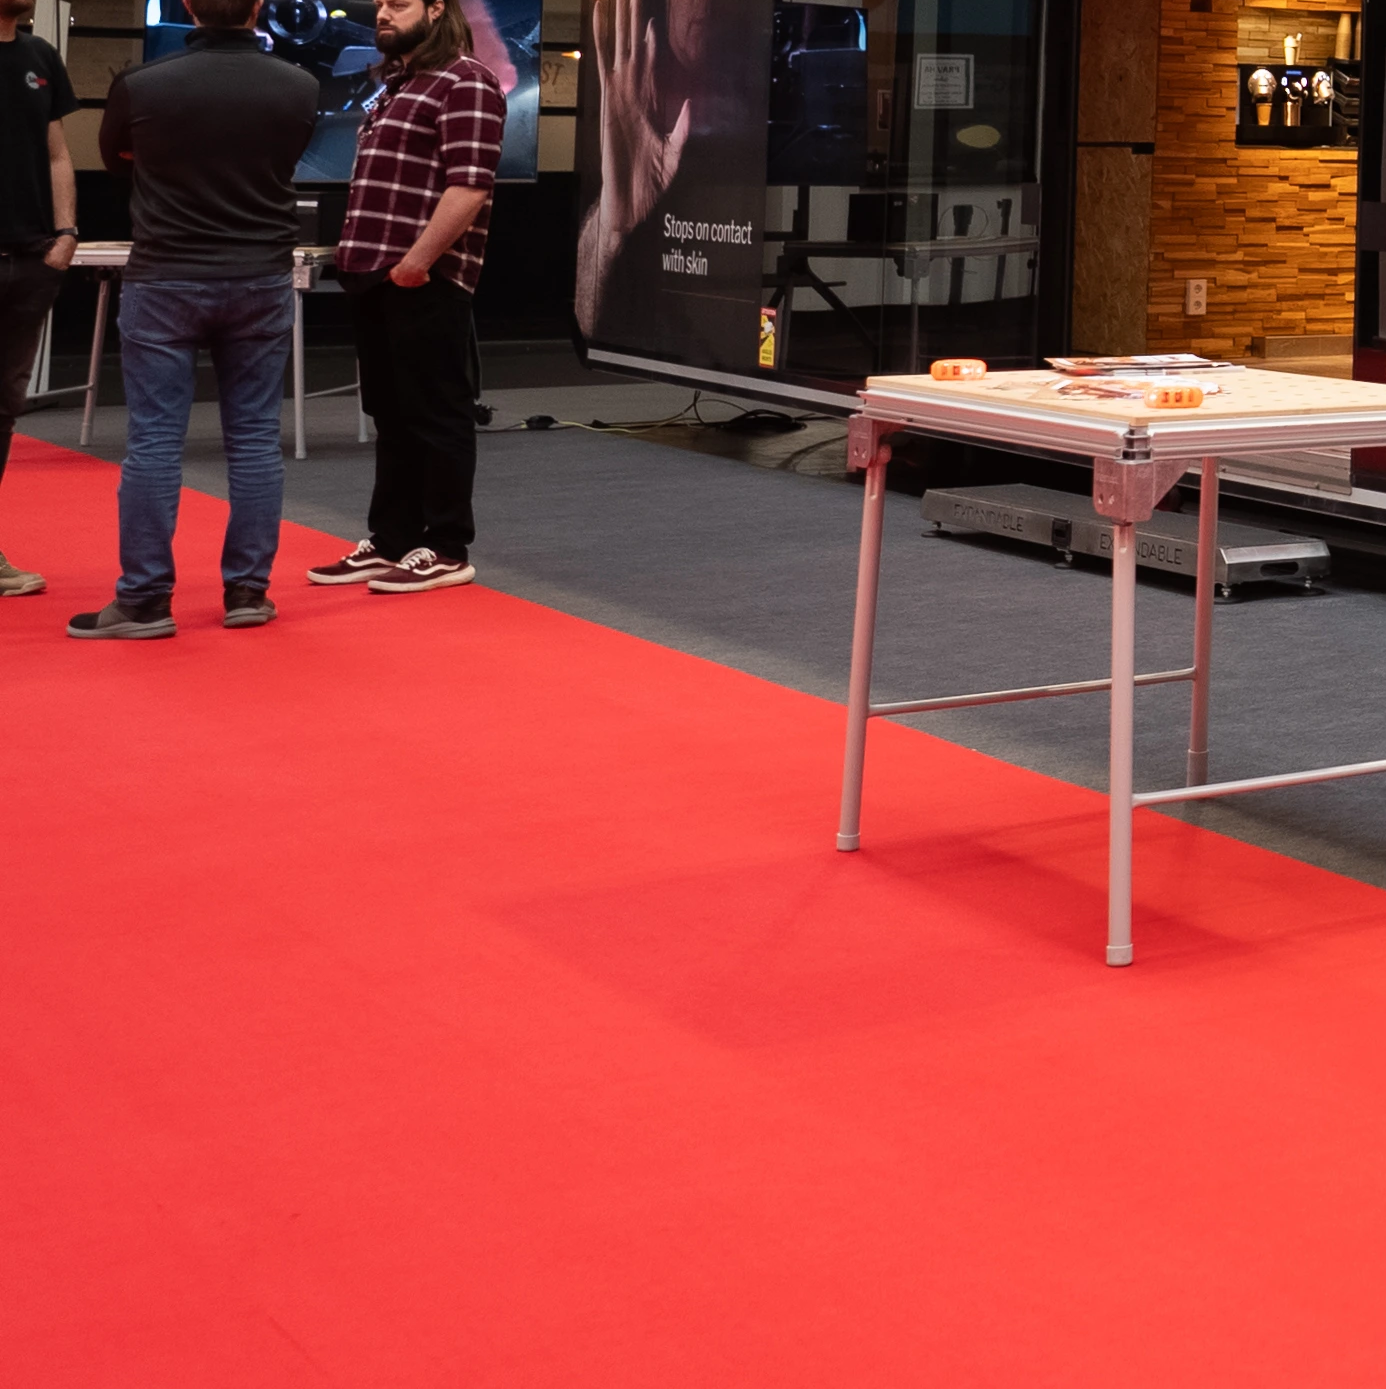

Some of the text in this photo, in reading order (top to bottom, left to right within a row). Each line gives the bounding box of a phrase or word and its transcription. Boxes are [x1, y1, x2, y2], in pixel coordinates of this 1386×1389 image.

[663, 213, 753, 245] Stops on contact
[662, 248, 708, 276] with skin
[953, 503, 1024, 532] EXPANDABLE
[1100, 534, 1183, 565] EXNDABLE
